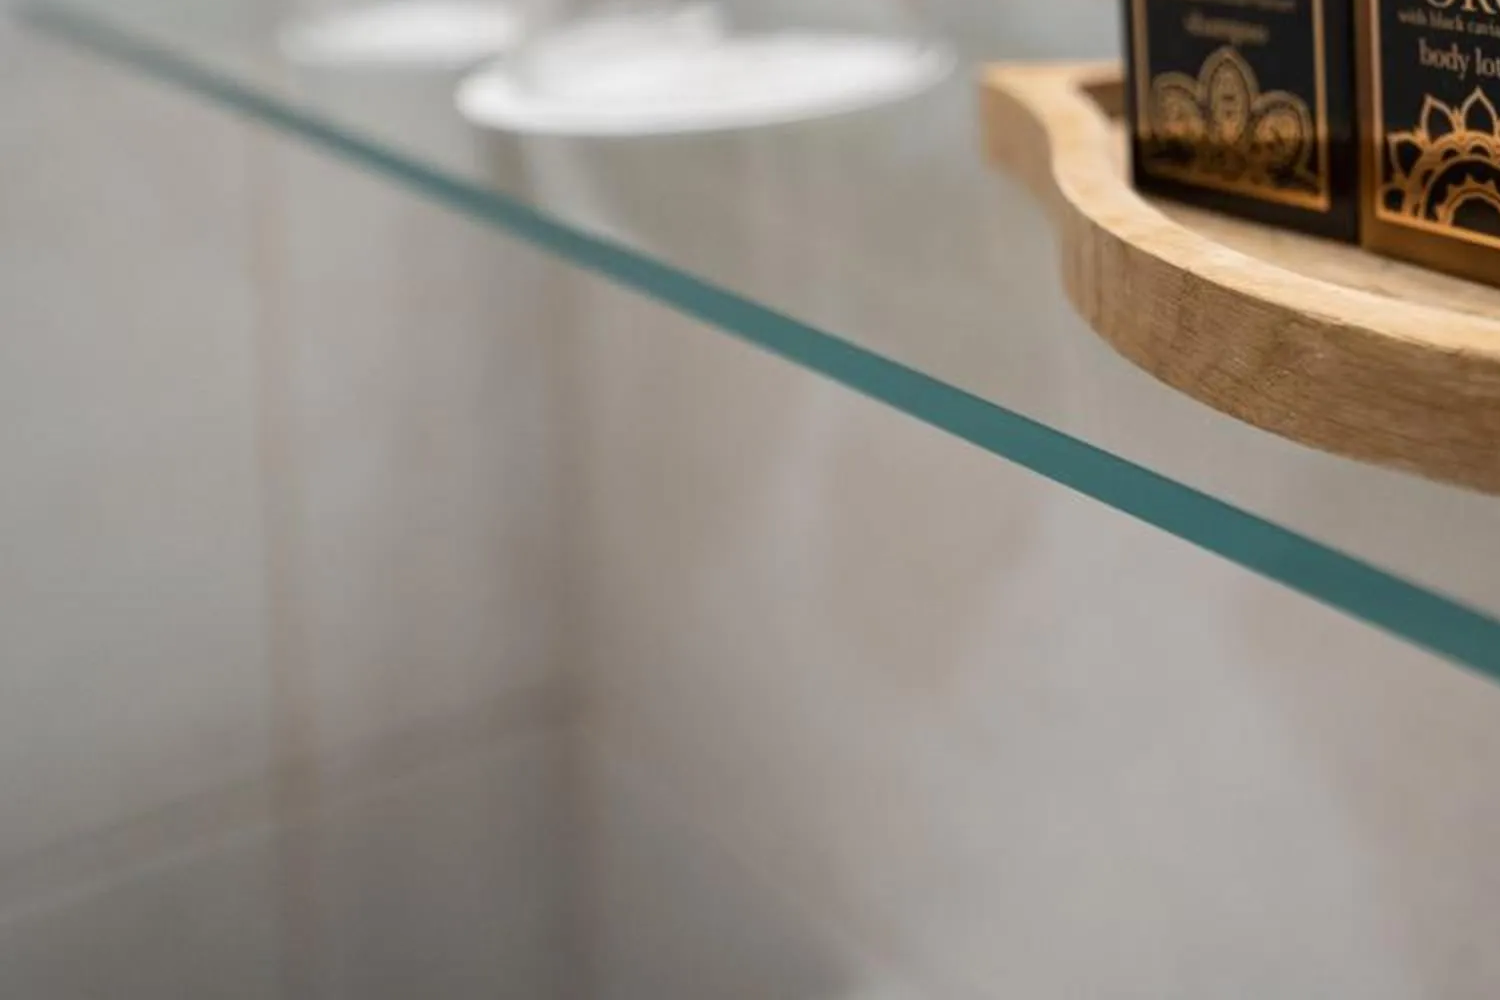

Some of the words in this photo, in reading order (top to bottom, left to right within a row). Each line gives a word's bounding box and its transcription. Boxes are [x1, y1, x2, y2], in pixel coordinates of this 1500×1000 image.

[1397, 8, 1427, 26] with
[1430, 12, 1464, 33] black
[1418, 39, 1470, 81] body
